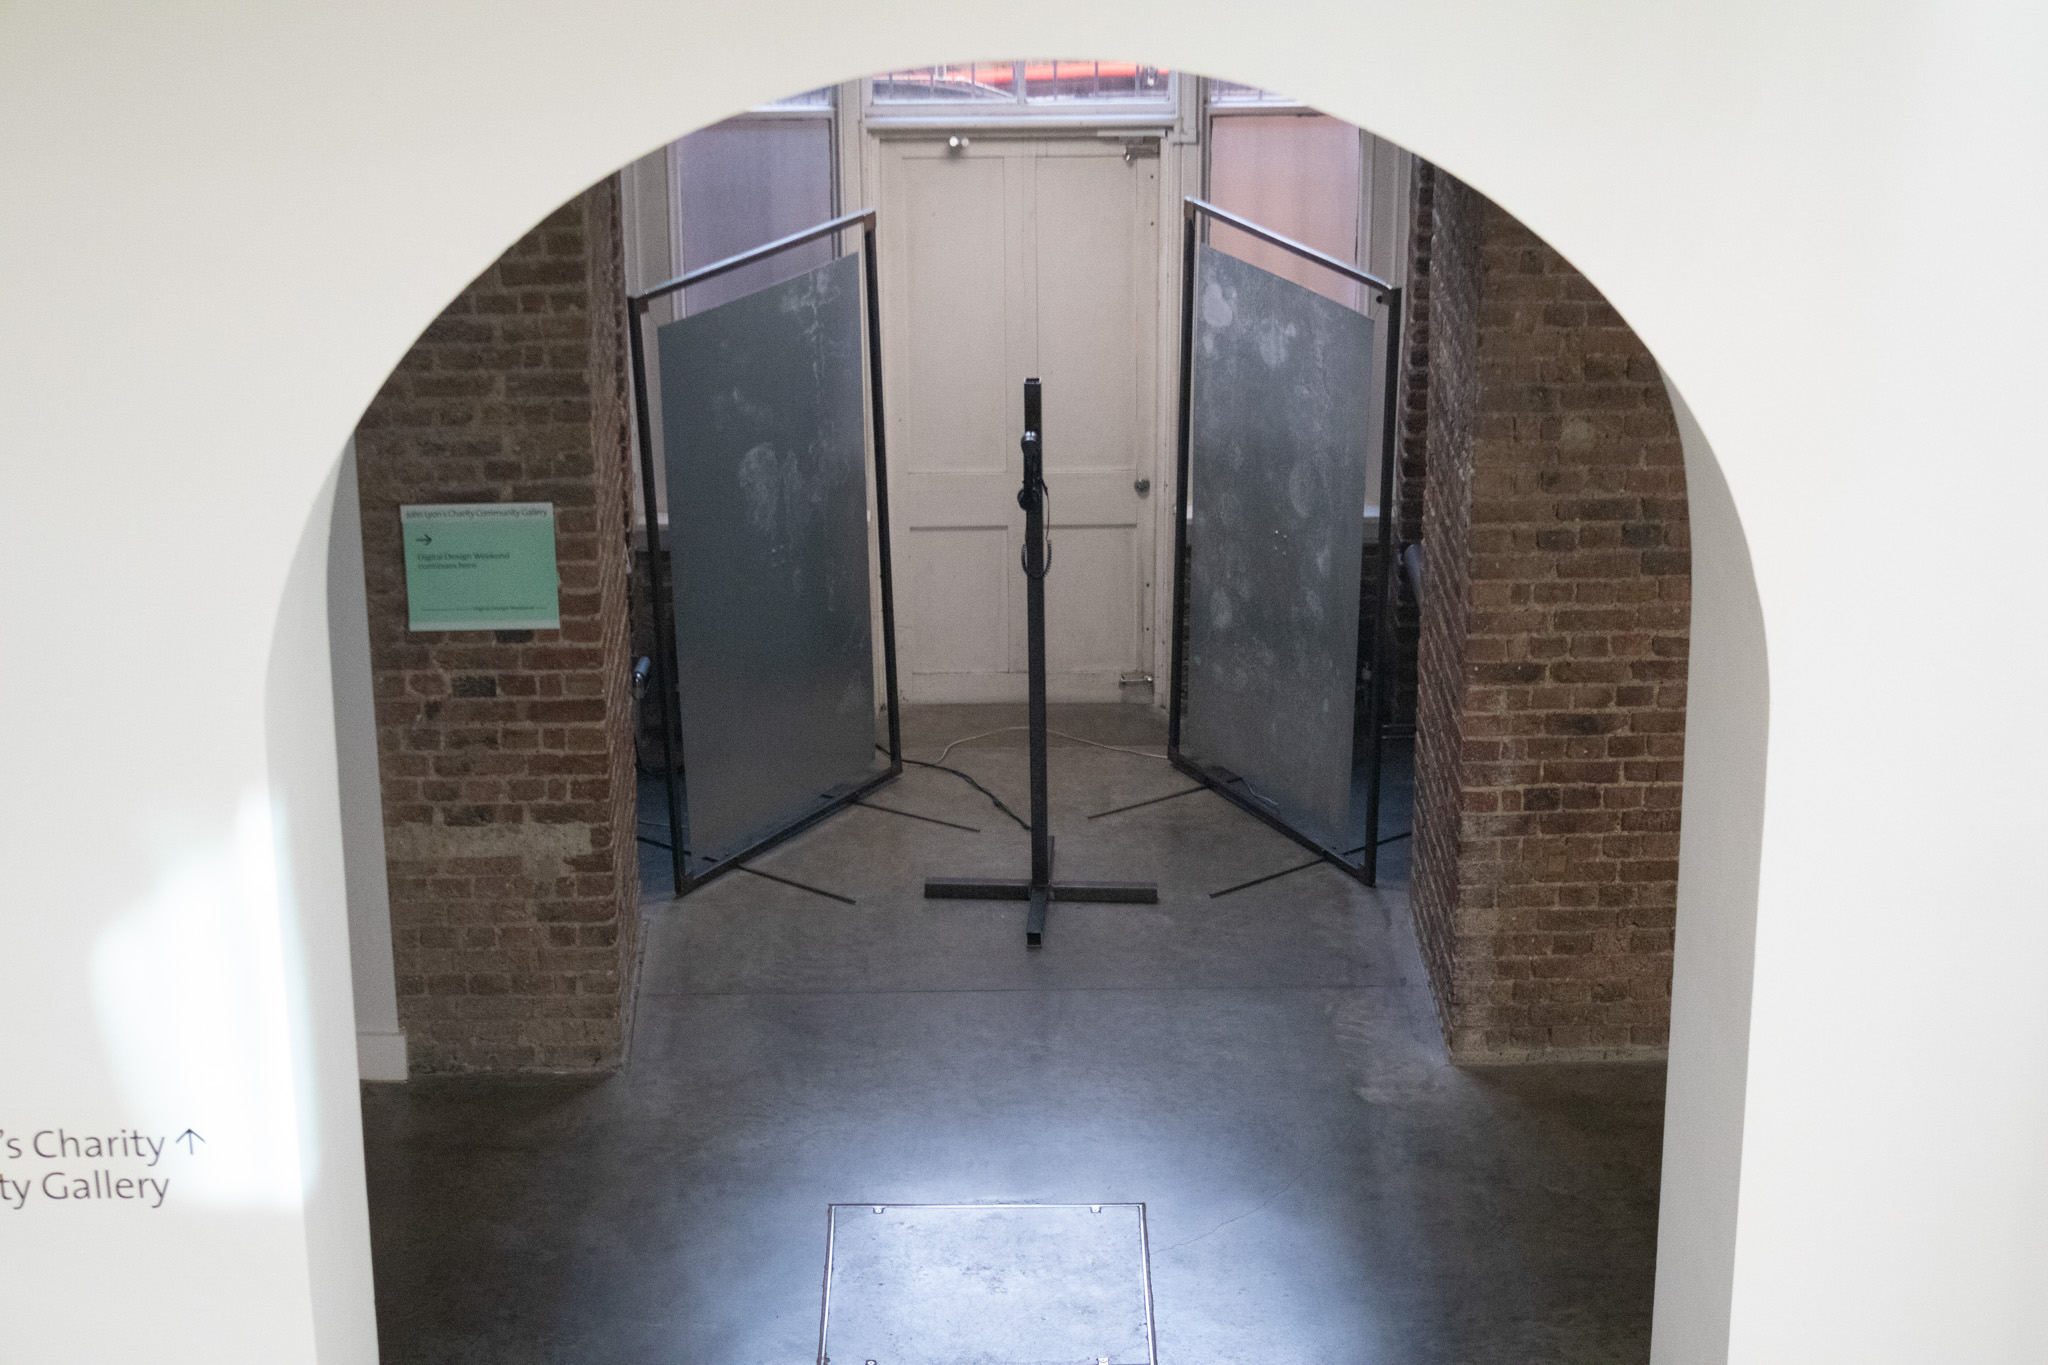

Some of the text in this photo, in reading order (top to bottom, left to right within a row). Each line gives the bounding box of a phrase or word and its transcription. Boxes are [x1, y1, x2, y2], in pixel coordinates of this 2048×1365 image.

[447, 509, 475, 520] Charity
[475, 508, 520, 518] Community
[521, 508, 548, 518] Gallery
[33, 1128, 166, 1167] Charity
[42, 1170, 170, 1209] Gallery
